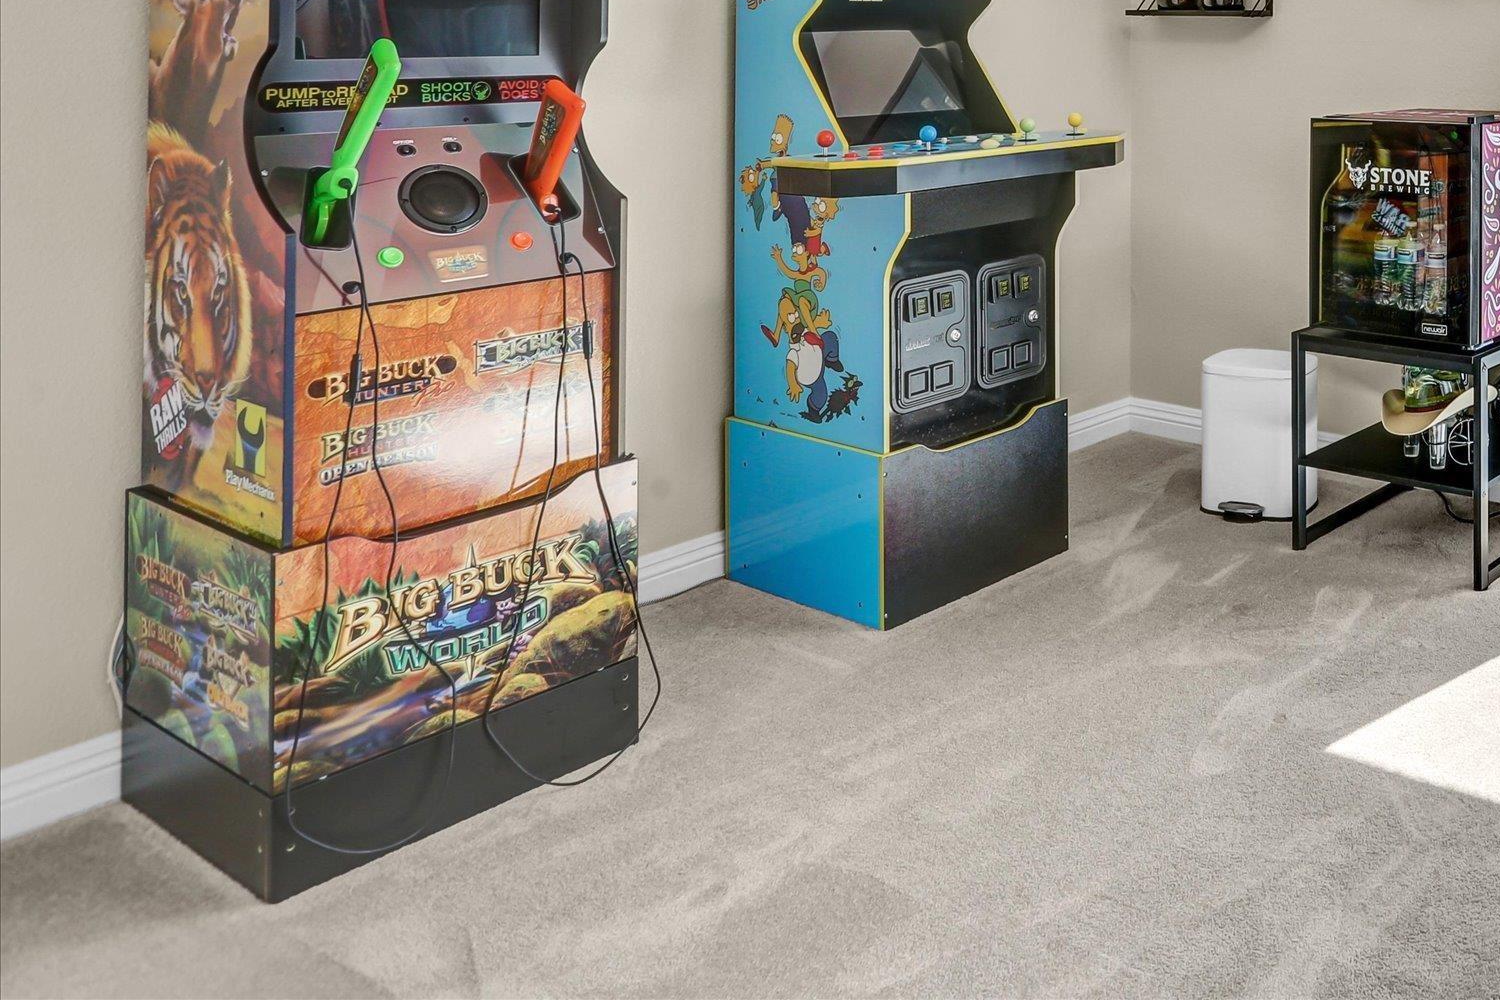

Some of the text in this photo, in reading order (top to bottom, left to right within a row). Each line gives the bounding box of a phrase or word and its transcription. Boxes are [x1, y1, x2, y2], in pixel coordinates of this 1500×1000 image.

[266, 86, 320, 100] PUMP
[421, 82, 471, 93] SHOOT
[499, 80, 539, 90] AVOID
[501, 89, 539, 100] DOES
[276, 99, 318, 108] AFTER
[322, 98, 353, 107] EVER
[422, 92, 471, 103] BUCKS
[1370, 167, 1431, 187] STONE
[1370, 184, 1431, 195] BREWING
[323, 355, 446, 406] BG BUCK
[150, 380, 183, 437] RAW
[155, 410, 188, 454] THRILLS
[321, 411, 441, 464] BIG BUCK
[225, 469, 242, 491] Play
[320, 460, 368, 485] OPEN
[325, 535, 596, 674] BIG BUCK
[383, 595, 550, 676] WORLD
